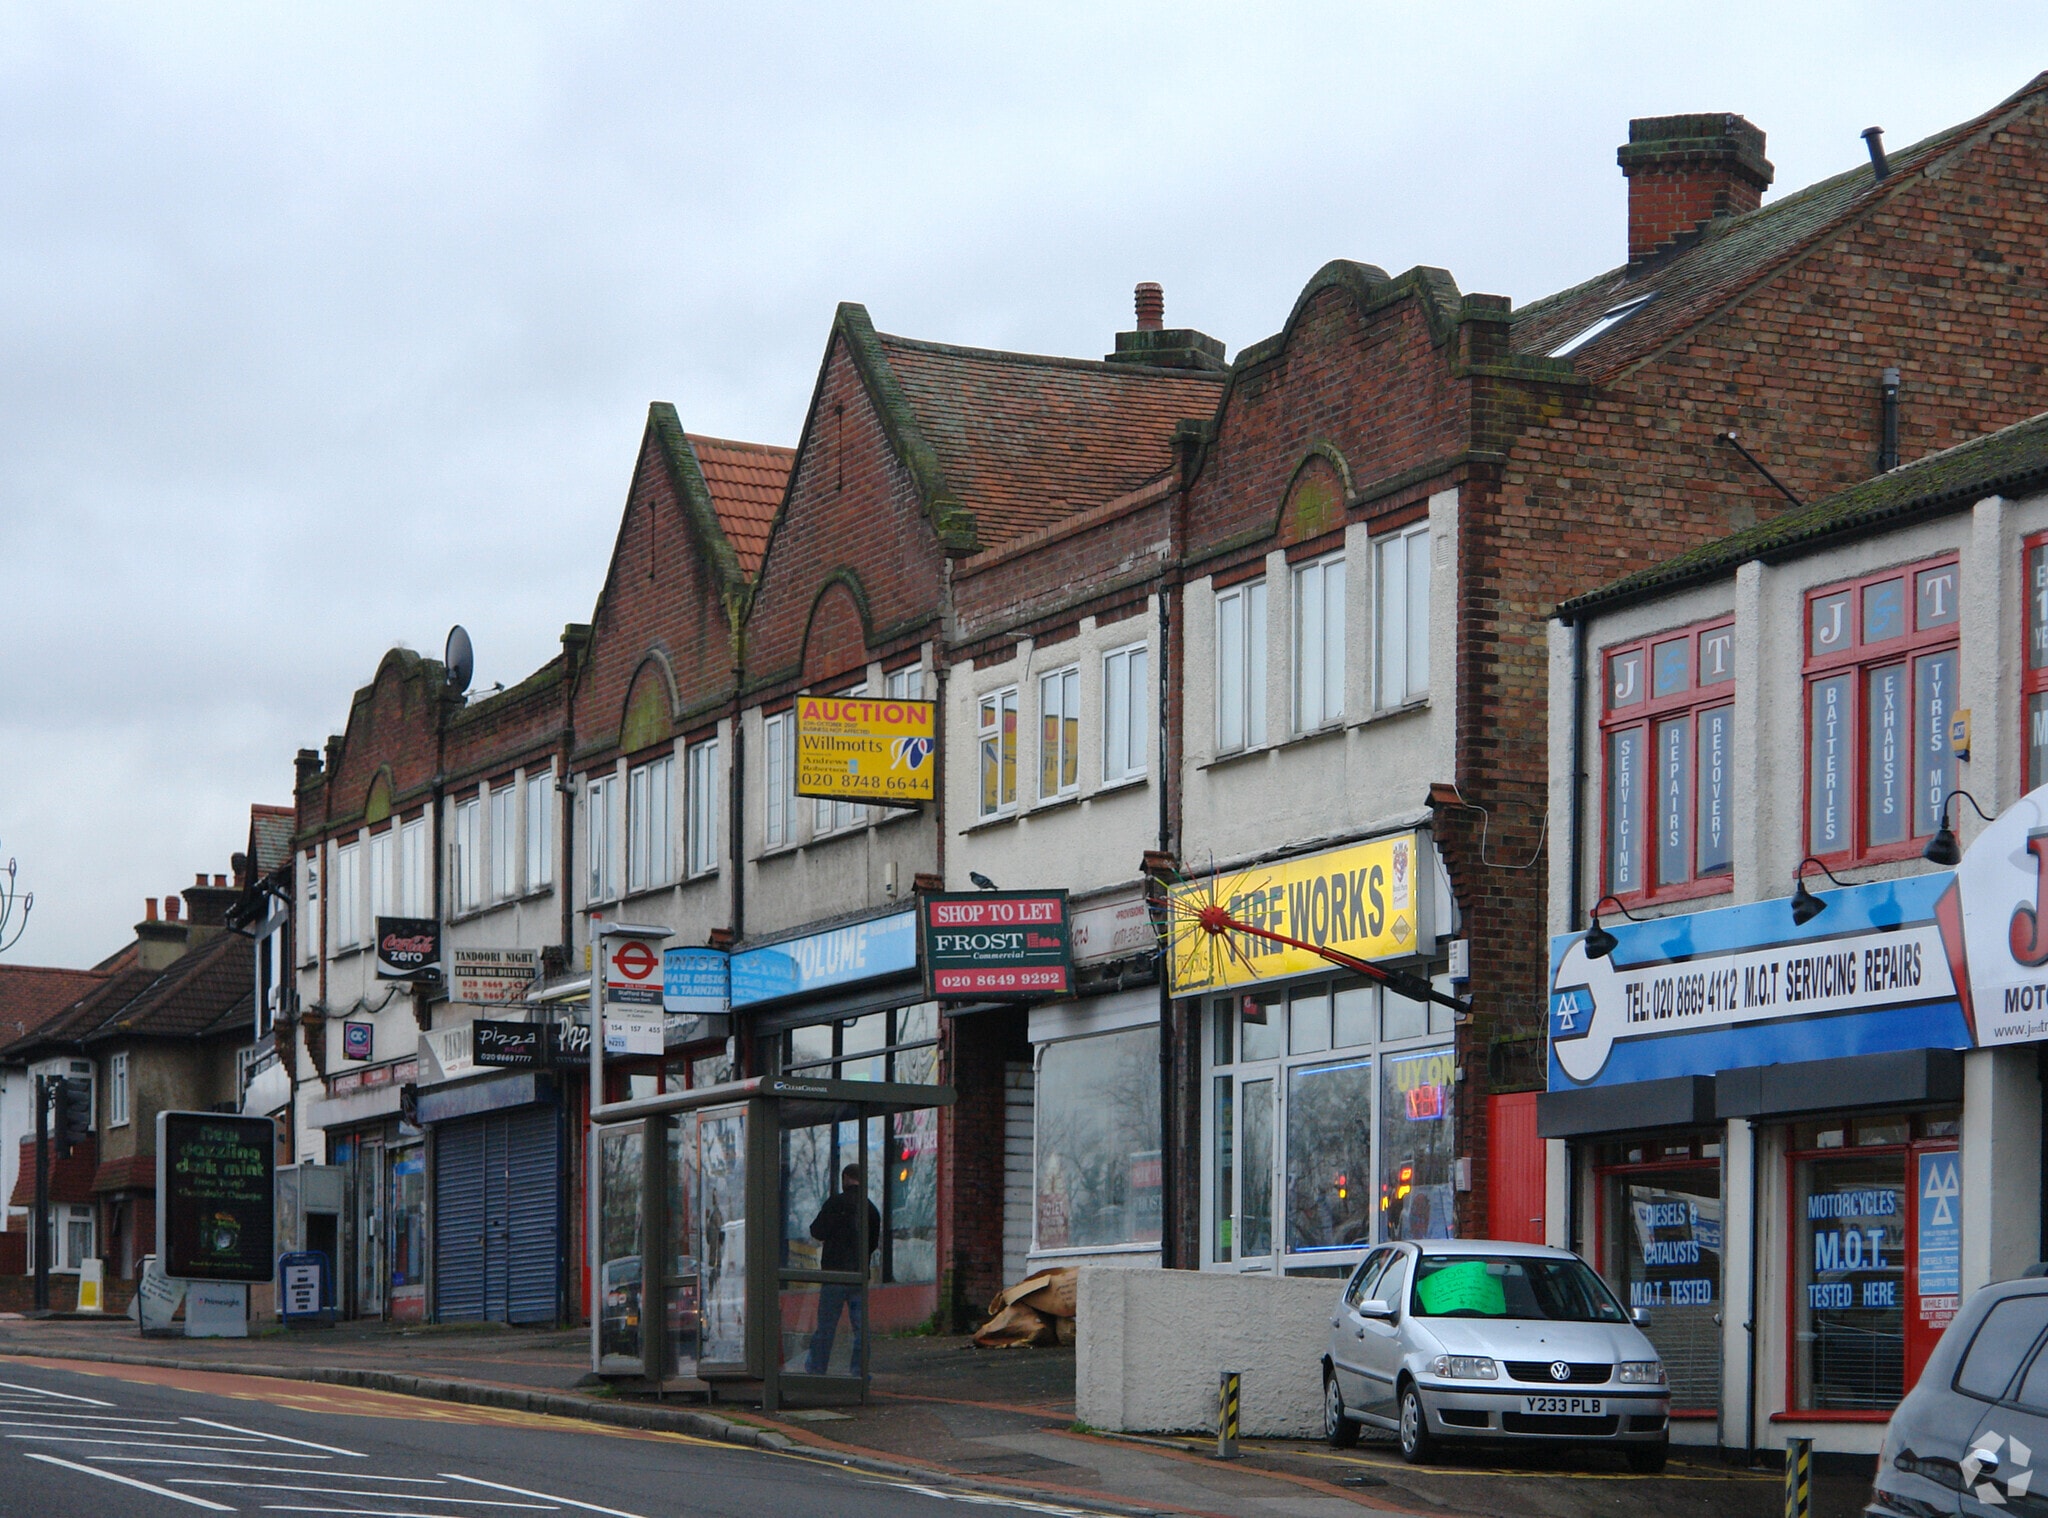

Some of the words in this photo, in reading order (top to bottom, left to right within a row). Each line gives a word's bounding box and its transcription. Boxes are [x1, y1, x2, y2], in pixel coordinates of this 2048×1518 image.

[1819, 601, 1846, 644] J
[1926, 574, 1951, 617] T
[1614, 660, 1638, 699] J
[1707, 635, 1730, 675] T
[802, 701, 927, 725] AUCTION
[1931, 663, 1943, 751] TYRES
[802, 735, 883, 753] Willmotts
[1883, 676, 1894, 814] EXHAUSTS
[803, 765, 848, 773] Robertson
[804, 757, 849, 765] Andrews
[1826, 687, 1837, 840] BATTERIES
[802, 773, 833, 787] 020
[841, 775, 881, 789] 8748
[886, 777, 930, 790] 6644
[1670, 729, 1680, 847] REPAIRS
[1712, 717, 1722, 849] RECOVERY
[1930, 769, 1942, 821] MOT
[1620, 740, 1630, 882] SERVICING
[937, 904, 984, 923] SHOP
[988, 903, 1014, 921] TO
[1018, 902, 1054, 920] LET
[789, 923, 867, 981] VOLUME
[935, 932, 1023, 951] FROST
[391, 951, 423, 962] zero
[455, 951, 500, 962] TANDOORI
[506, 952, 533, 963] NIGHT
[973, 950, 1025, 960] Commercial
[476, 967, 497, 976] HOME
[664, 974, 692, 984] HAIR
[942, 975, 971, 987] 020
[976, 974, 1016, 986] 8649
[1021, 973, 1060, 984] 9292
[1625, 981, 1650, 1023] TEL:
[1653, 977, 1674, 1020] 020
[1676, 972, 1705, 1017] 8669
[1707, 967, 1738, 1013] 4112
[1744, 961, 1779, 1008] M.O.T
[1785, 951, 1856, 1003] SERVICING
[1864, 941, 1922, 993] REPAIRS
[681, 985, 726, 996] TANNING
[479, 1026, 536, 1046] Pizza
[558, 1016, 591, 1052] Pizz
[223, 1160, 264, 1177] mint
[1645, 1202, 1685, 1227] DIESELS
[1689, 1202, 1698, 1224] &
[1808, 1190, 1895, 1218] MOTORCYCLES
[1644, 1239, 1700, 1265] CATALYSTS
[1815, 1228, 1887, 1270] M.O.T.
[204, 1298, 240, 1307] Primesight
[1630, 1281, 1665, 1306] M.O.T.
[1669, 1279, 1711, 1304] TESTED
[1808, 1283, 1852, 1308] TESTED
[1862, 1281, 1895, 1306] HERE
[1923, 1299, 1942, 1309] WHILE
[1526, 1397, 1566, 1412] Y233
[1571, 1399, 1601, 1413] PLB
